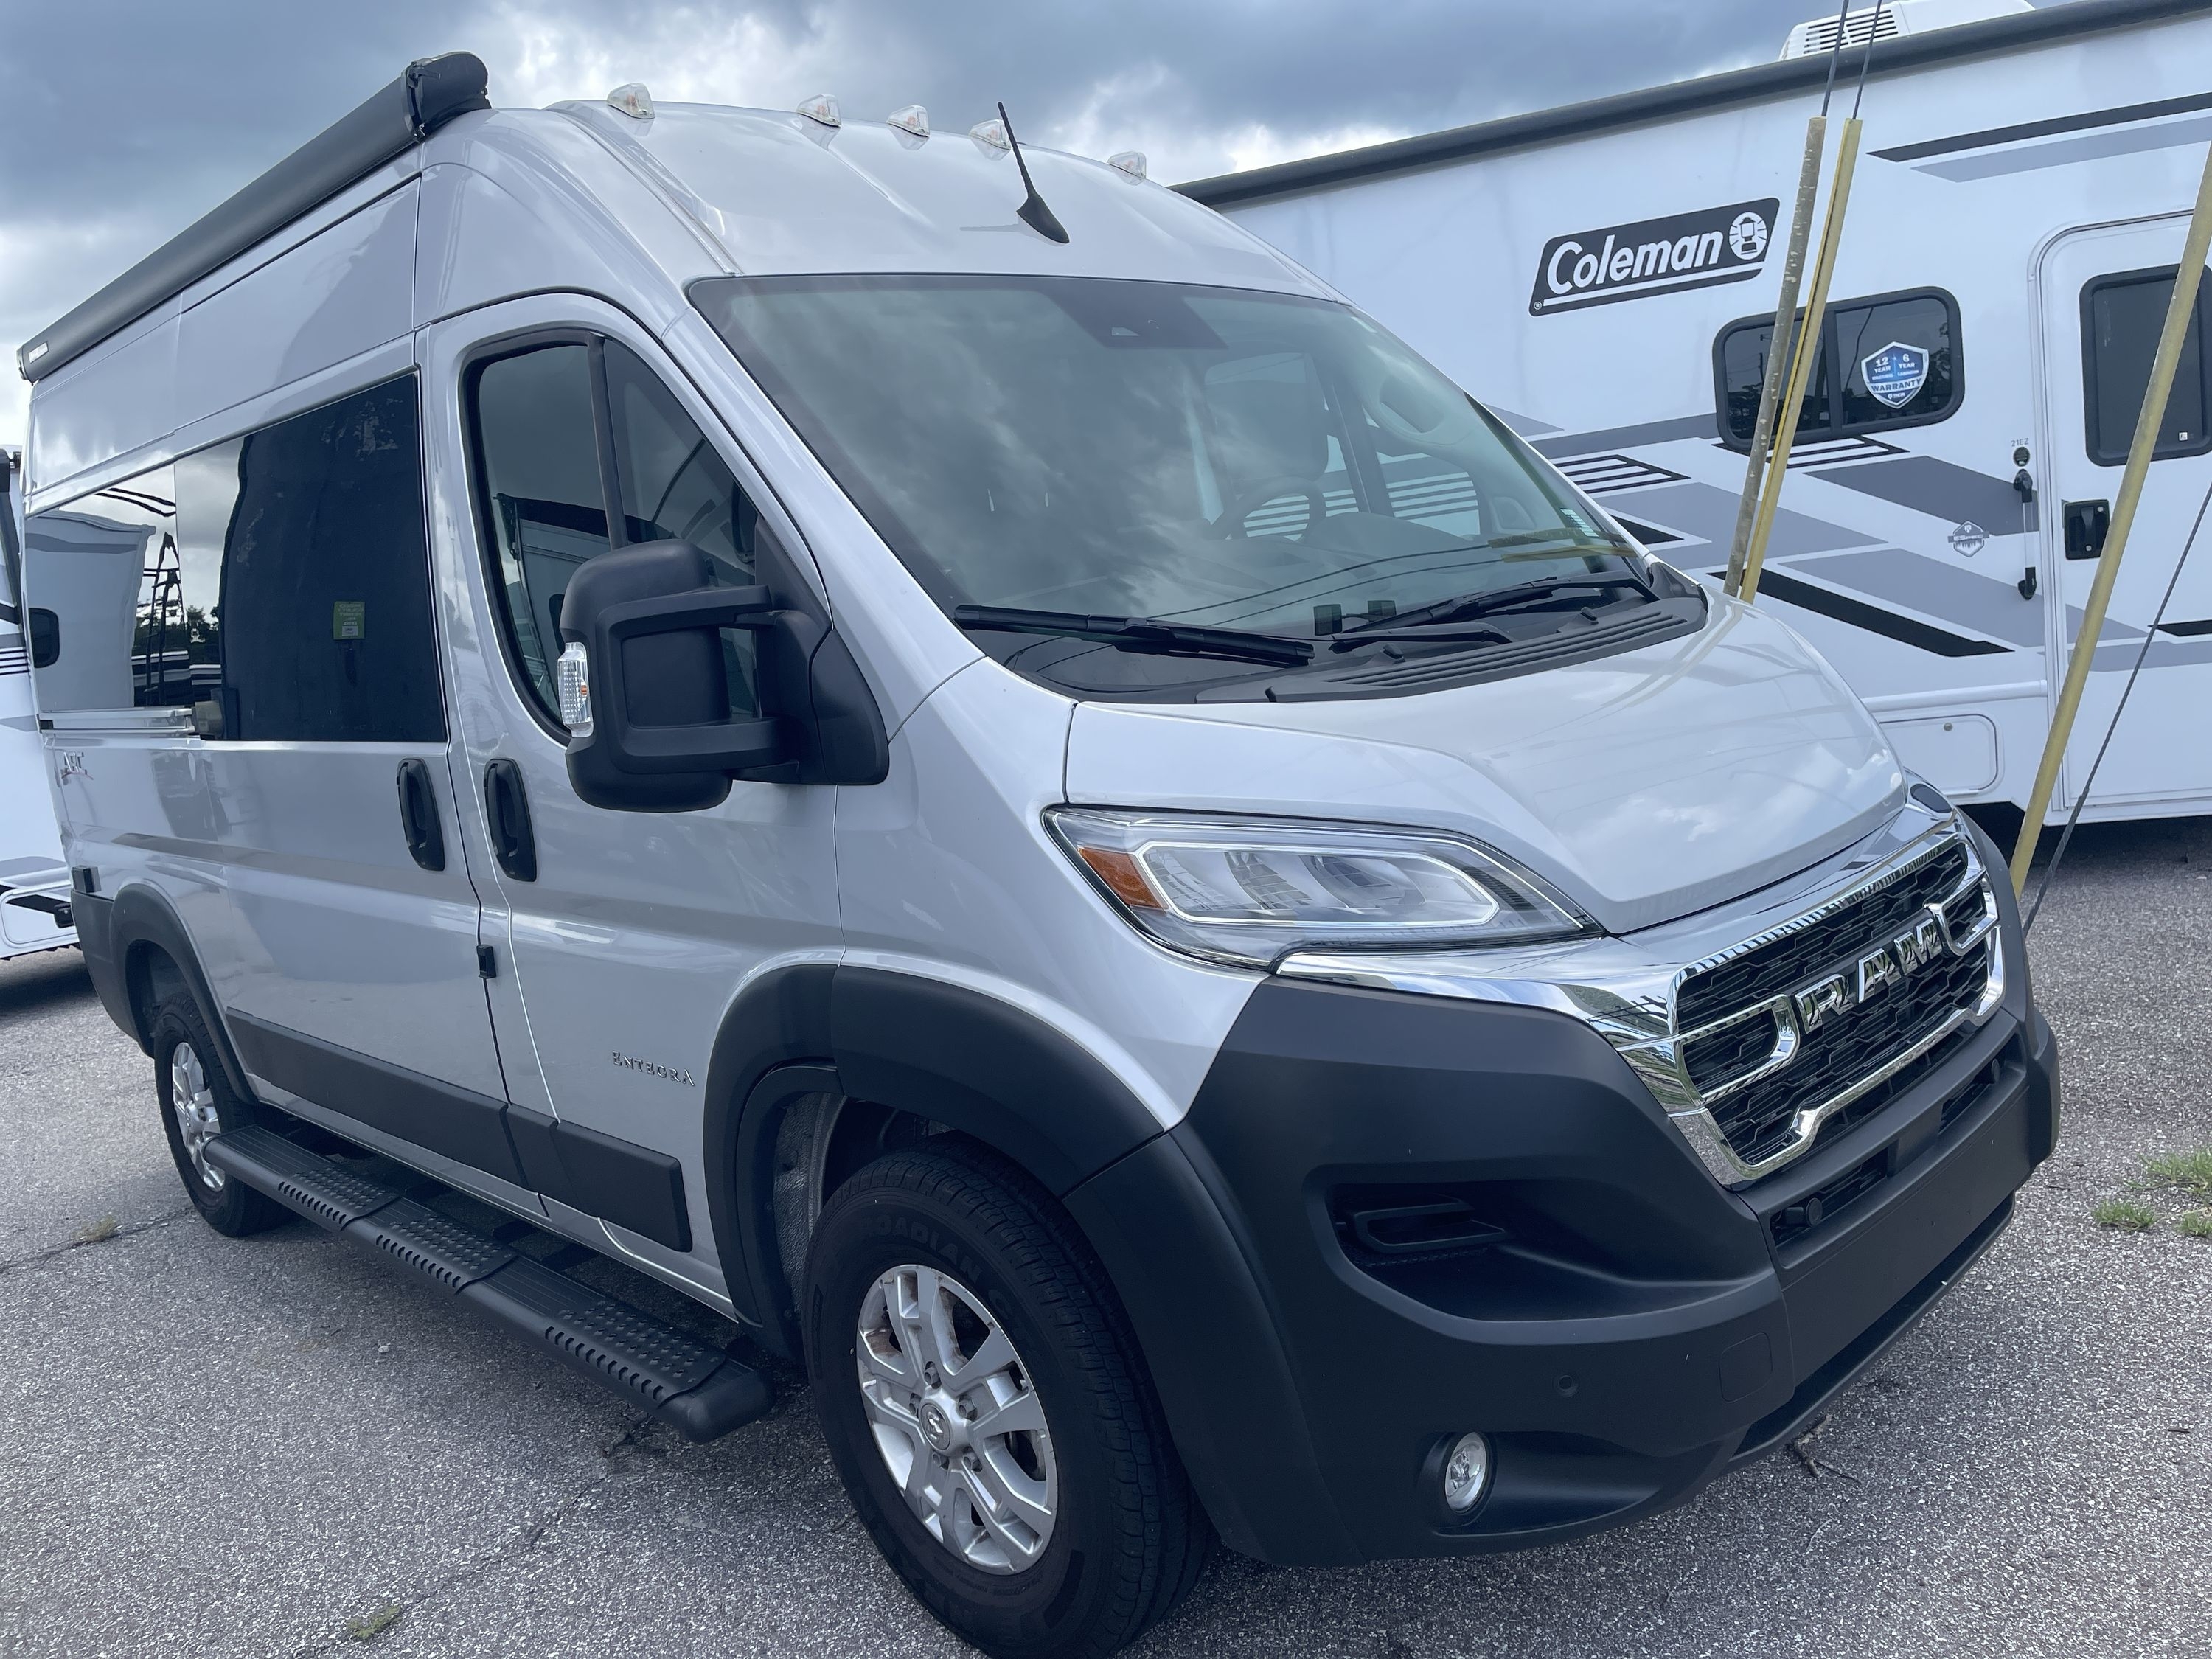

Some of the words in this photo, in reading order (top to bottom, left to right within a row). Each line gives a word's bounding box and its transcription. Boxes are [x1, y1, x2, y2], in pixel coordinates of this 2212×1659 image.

[1547, 231, 1724, 295] Coleman
[1875, 357, 1889, 367] 12
[1902, 353, 1910, 362] 6
[1874, 365, 1891, 373] YEAR
[1871, 378, 1921, 392] WARRANTY
[1795, 918, 1944, 1034] RAM
[612, 1050, 695, 1087] ENTEGRA
